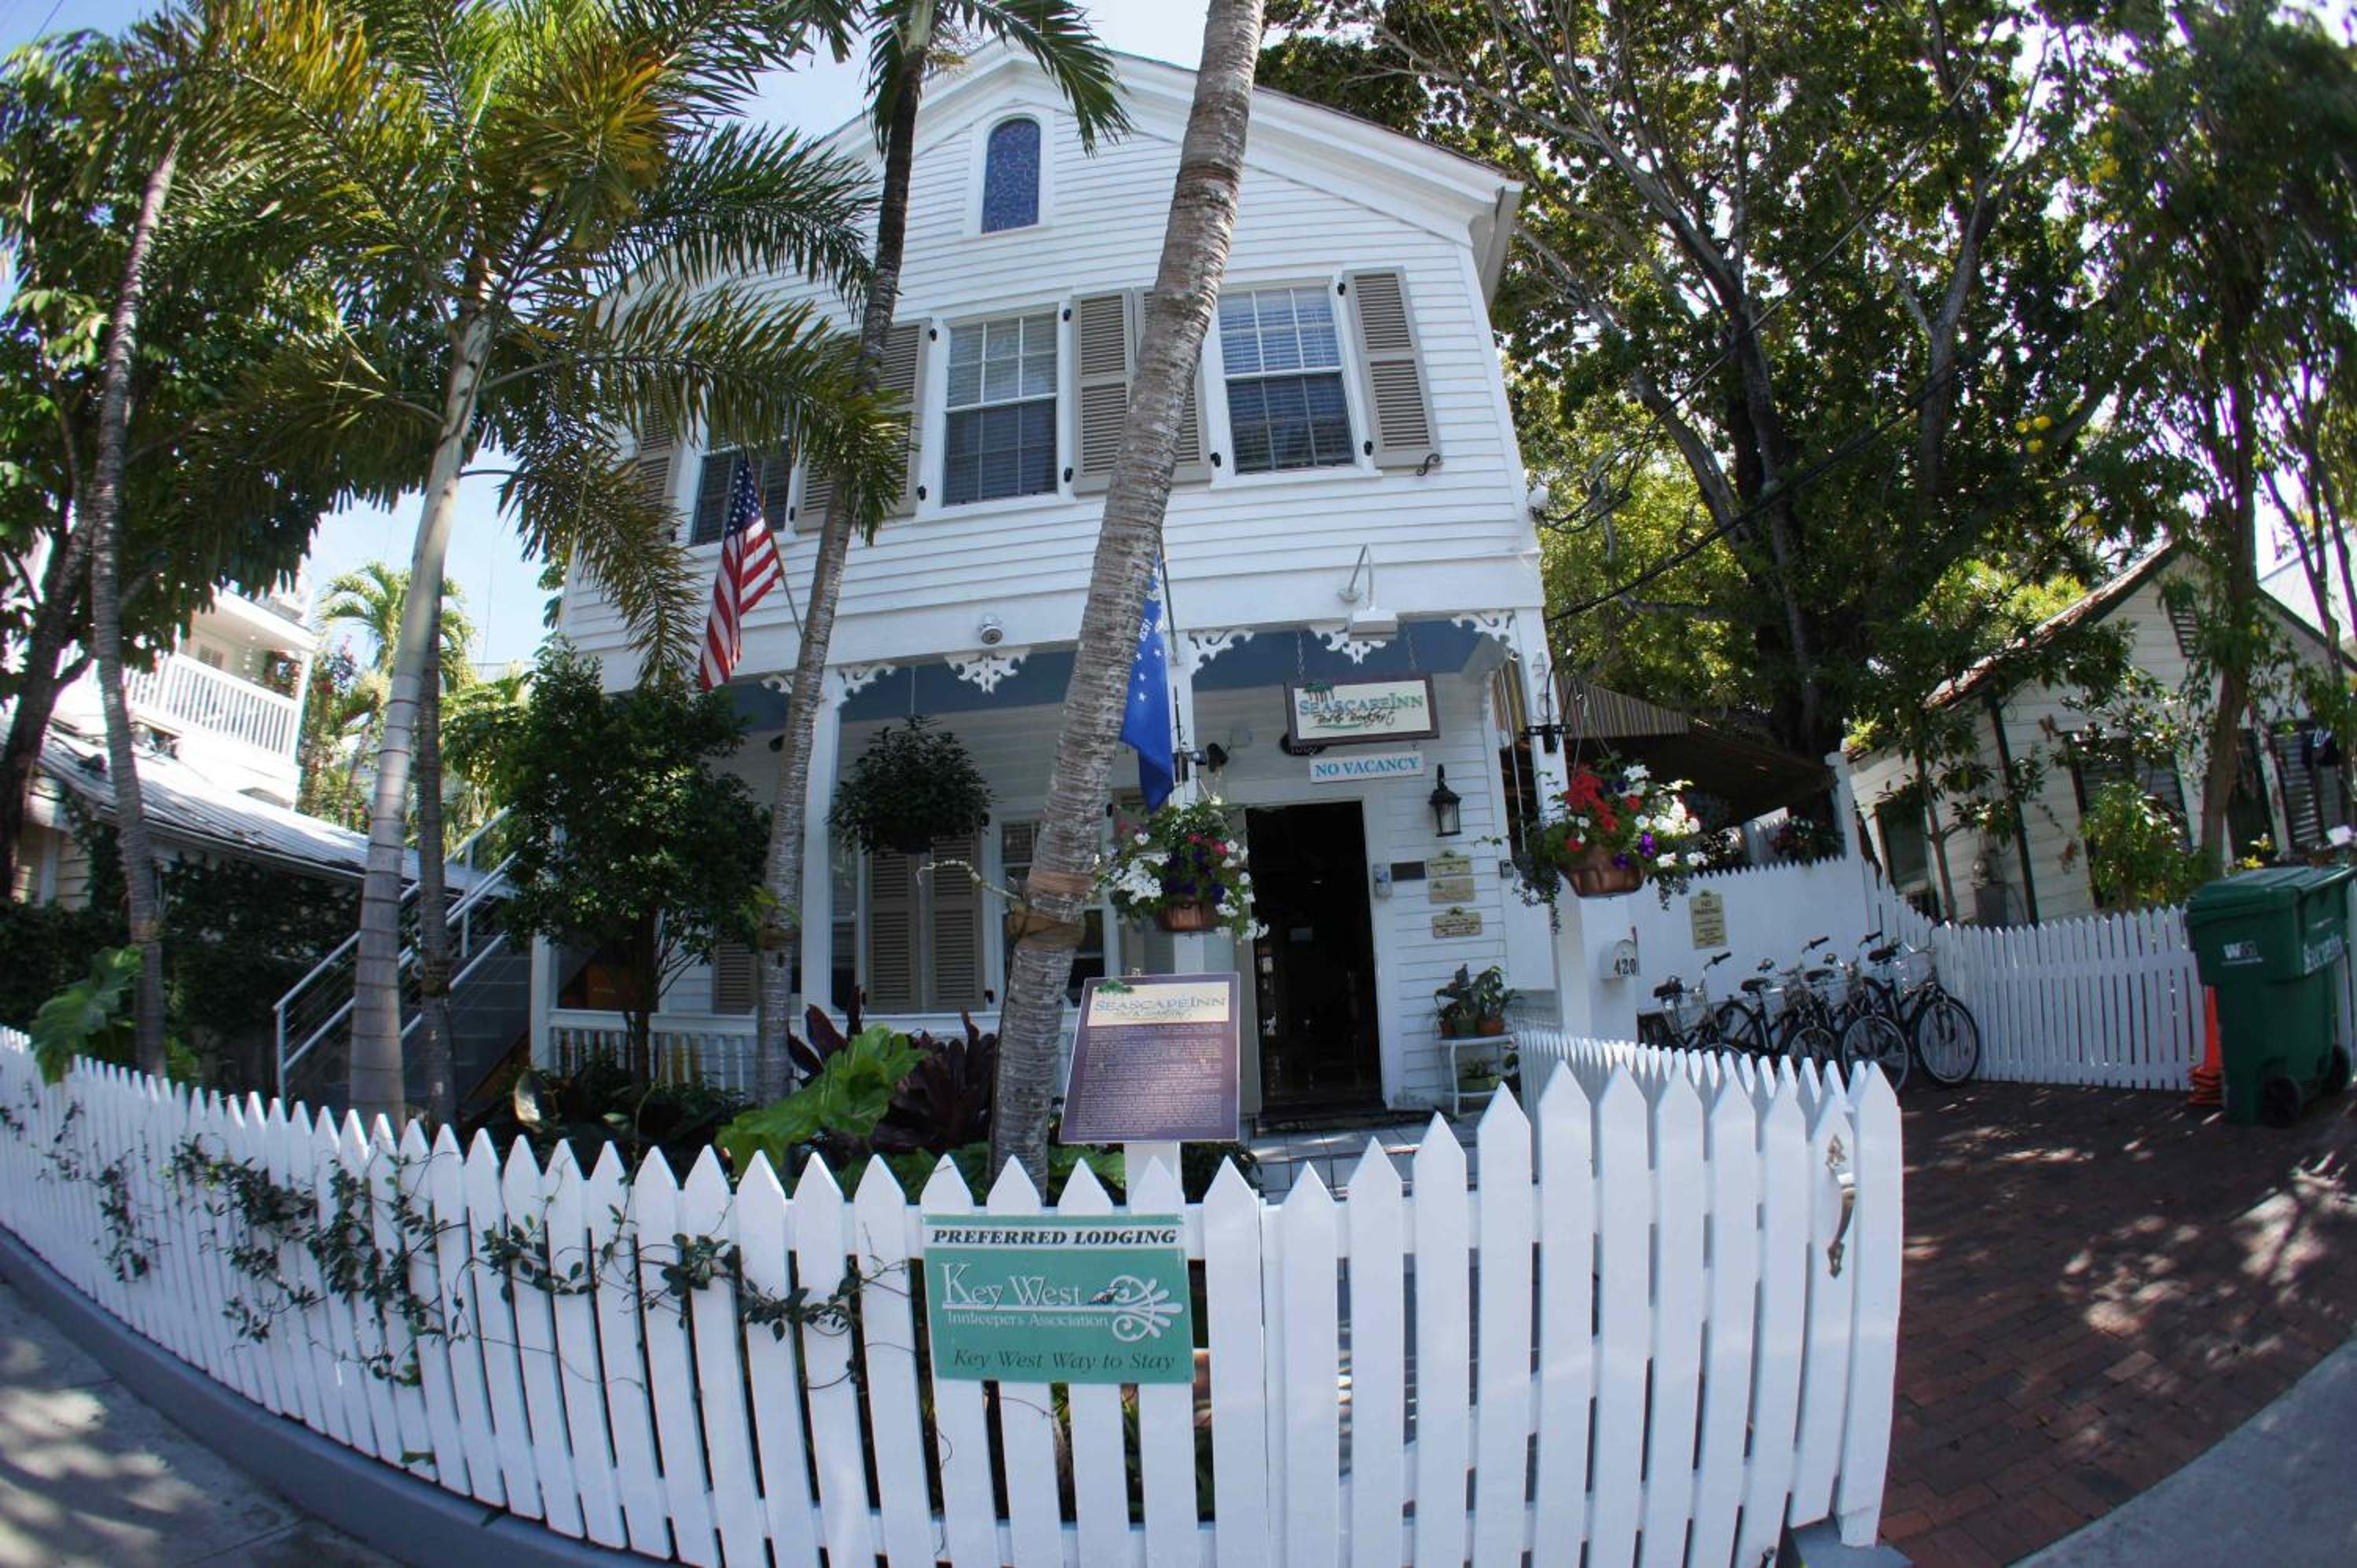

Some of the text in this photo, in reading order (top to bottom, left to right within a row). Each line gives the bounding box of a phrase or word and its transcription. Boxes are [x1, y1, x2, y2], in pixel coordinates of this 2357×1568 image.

[1314, 757, 1419, 777] NO VACANCY
[1614, 958, 1637, 976] 420
[933, 1229, 1177, 1245] PREFERRED LODGING
[940, 1262, 1082, 1309] Key West
[1029, 1313, 1109, 1328] Association
[954, 1350, 1175, 1373] Key West Way to Stay
